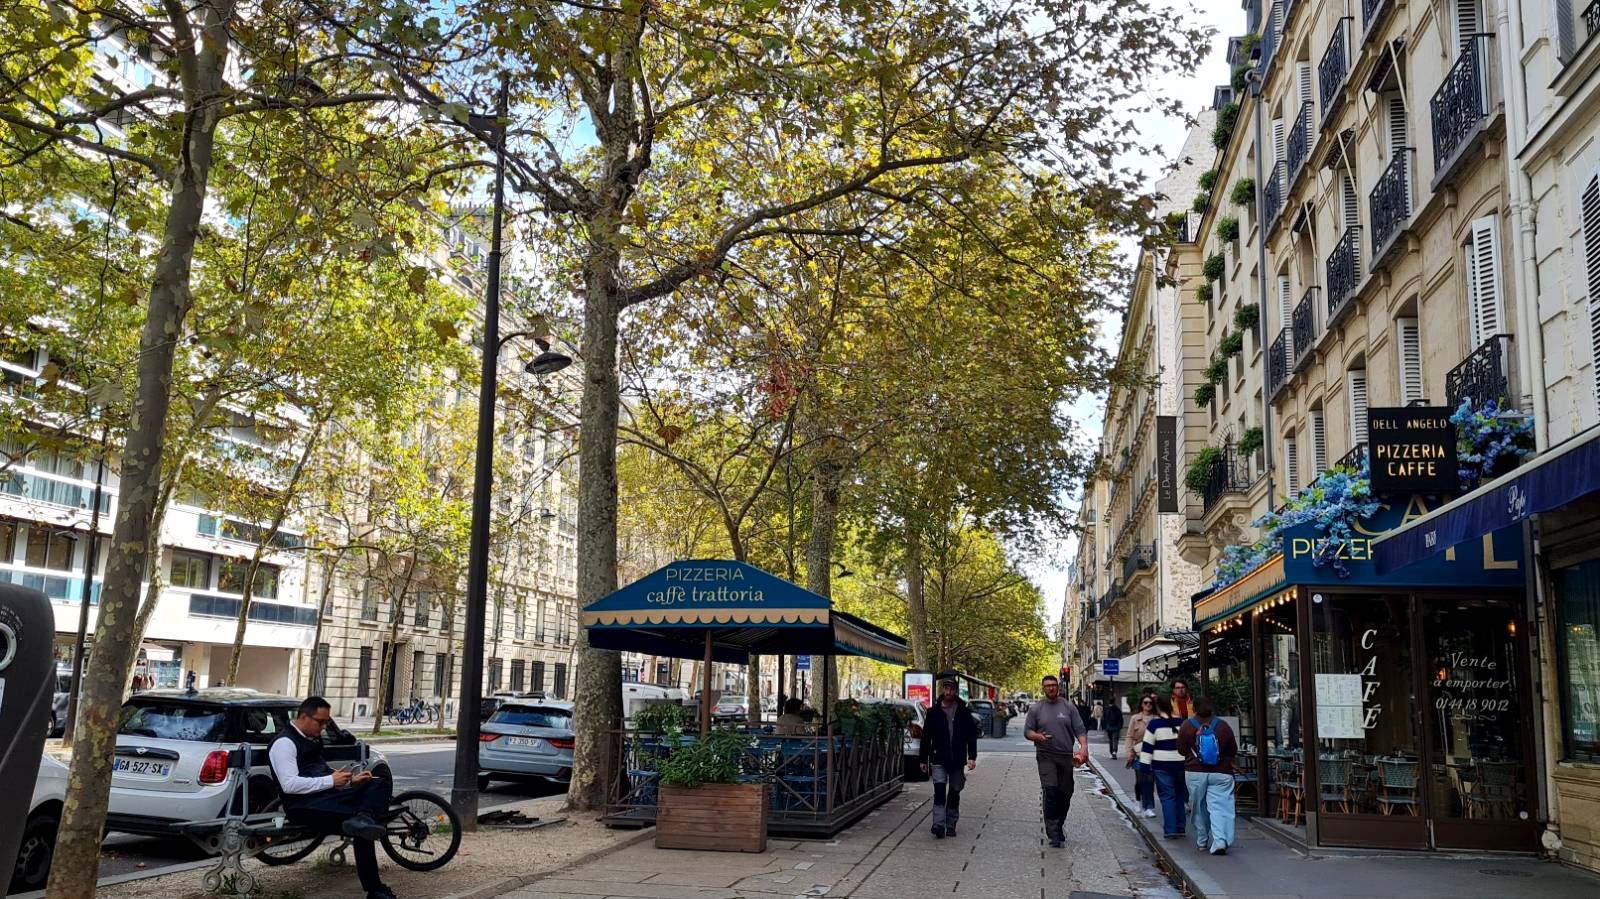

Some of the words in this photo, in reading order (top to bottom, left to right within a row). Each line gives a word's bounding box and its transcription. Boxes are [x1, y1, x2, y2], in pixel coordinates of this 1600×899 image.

[1373, 420, 1399, 430] DELL
[1406, 419, 1447, 429] ANGELO
[1377, 444, 1445, 459] PIZZERIA
[1388, 462, 1437, 476] CAFFE
[666, 568, 744, 582] PIZZERIA
[646, 585, 686, 605] caffè
[692, 586, 764, 602] trattoria
[1450, 651, 1497, 670] Vente
[1361, 629, 1382, 729] CAFÉ
[1446, 678, 1509, 692] emporter
